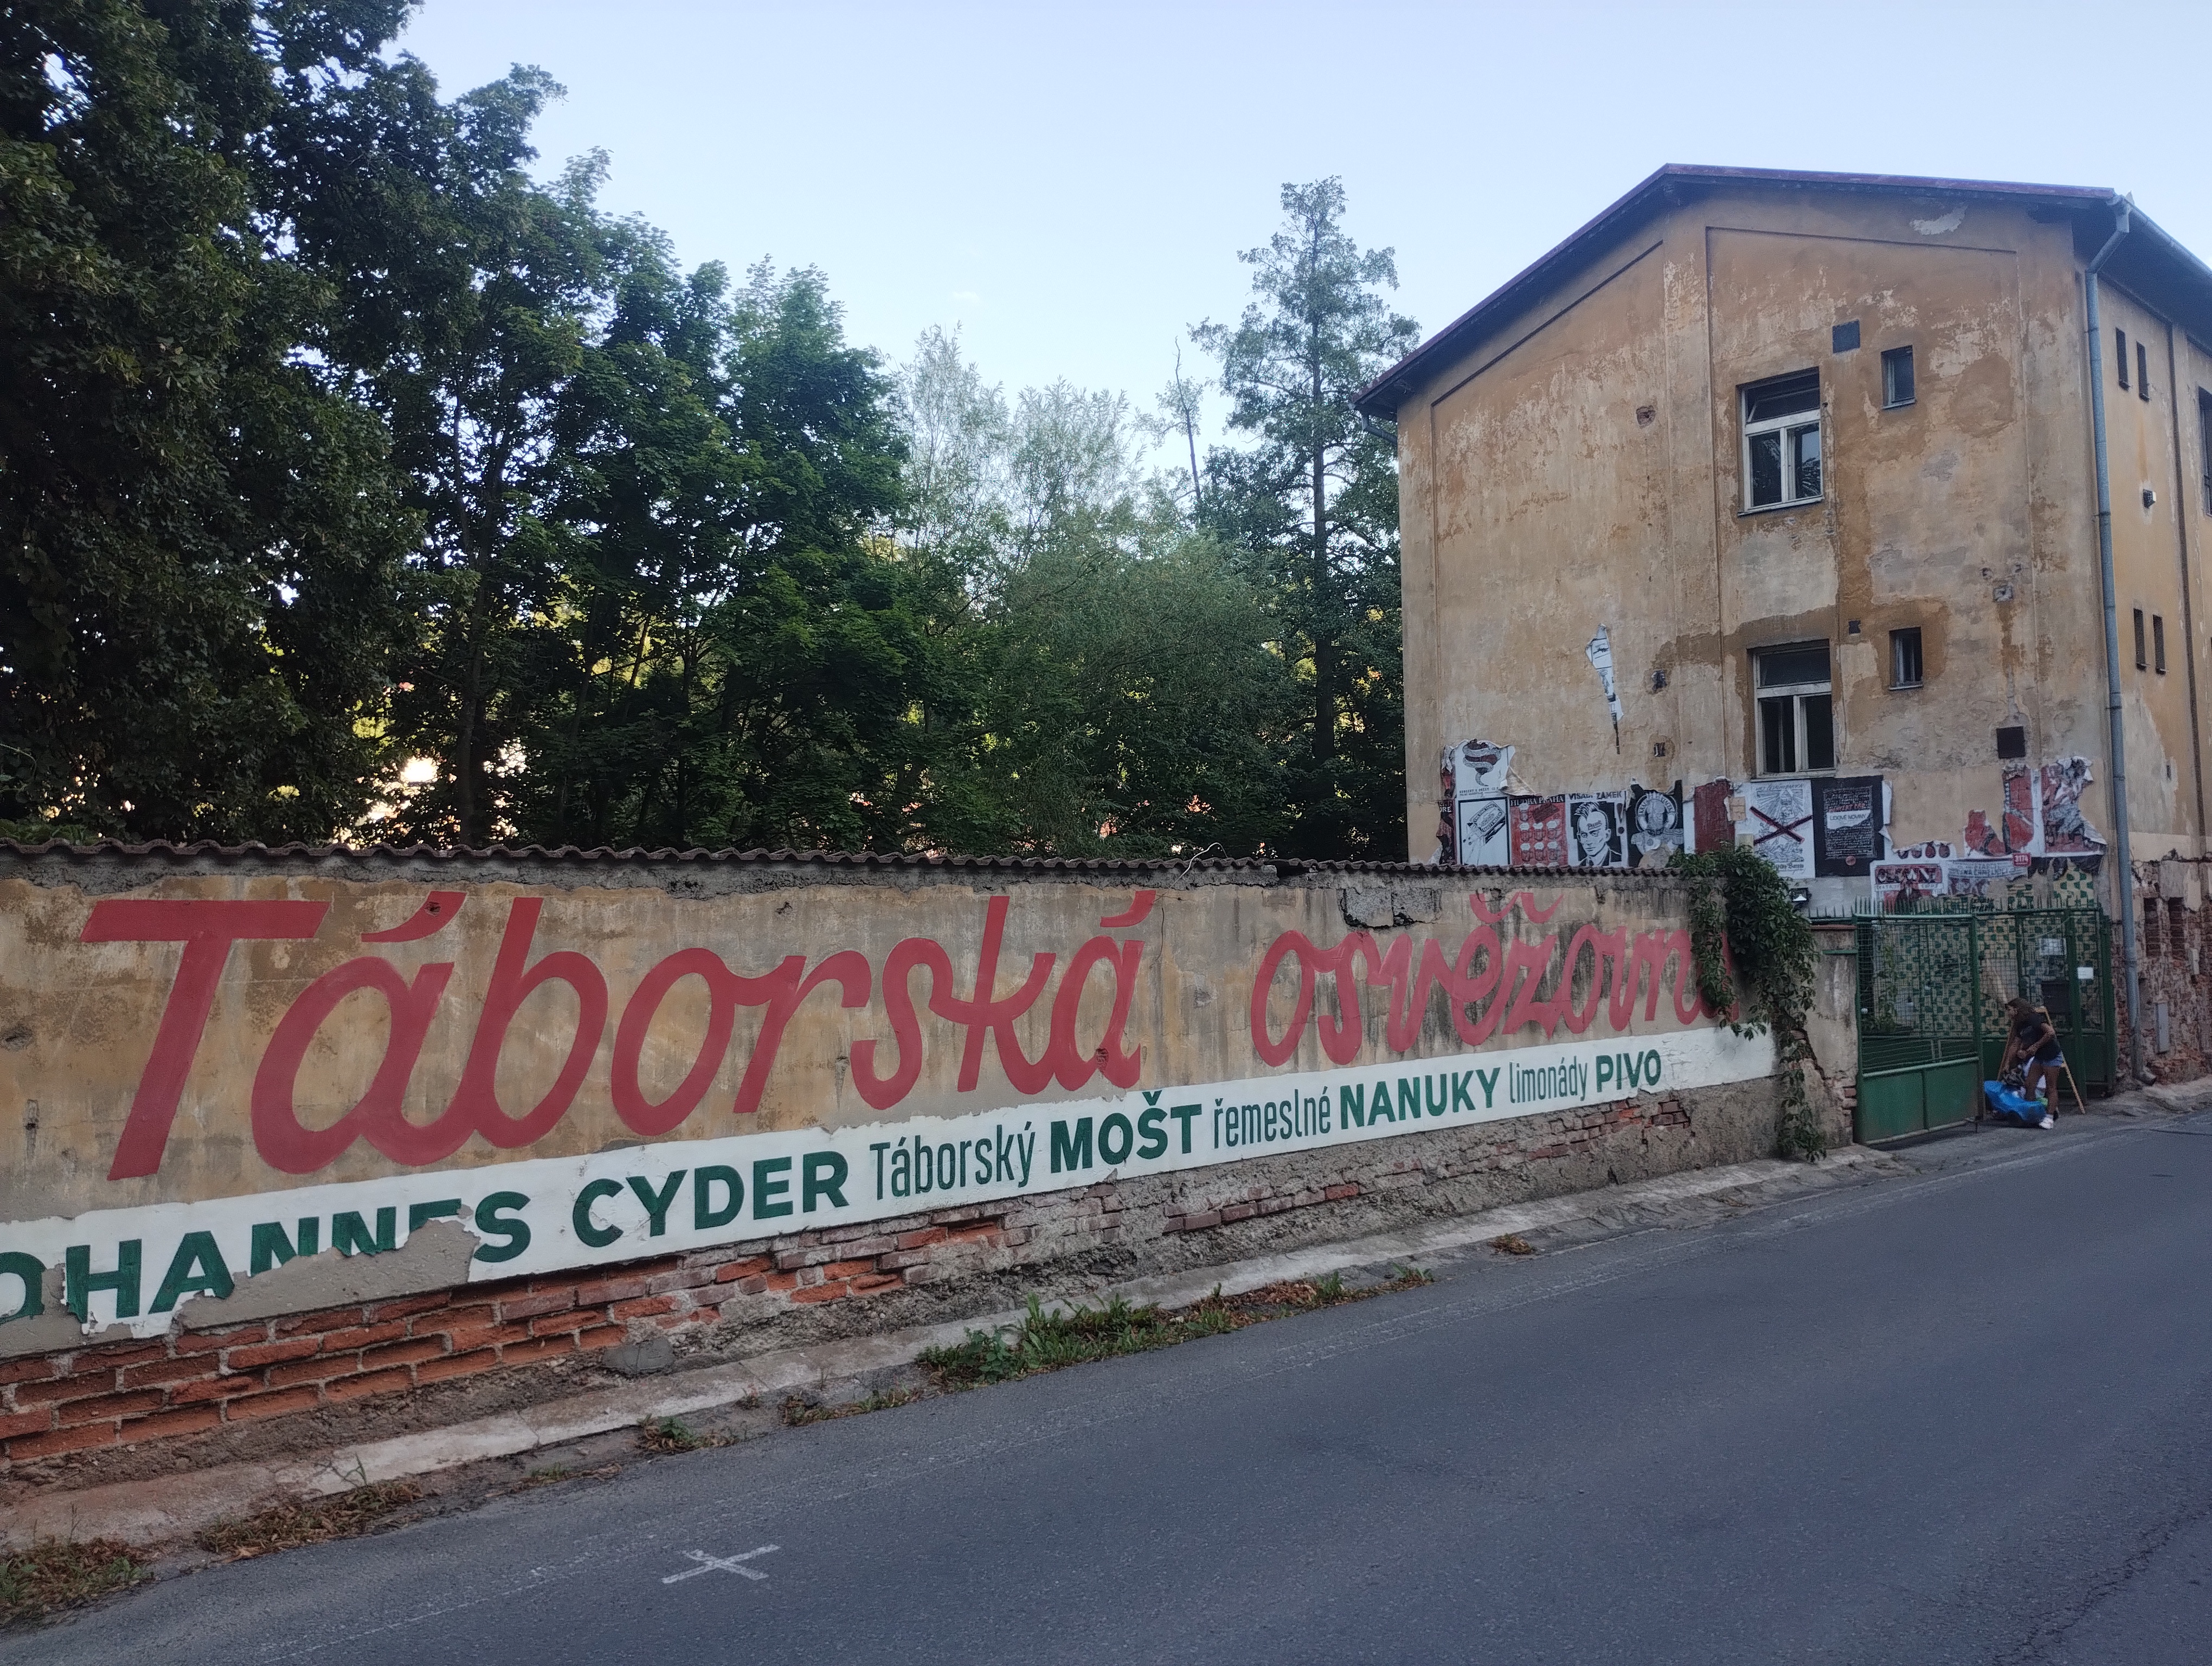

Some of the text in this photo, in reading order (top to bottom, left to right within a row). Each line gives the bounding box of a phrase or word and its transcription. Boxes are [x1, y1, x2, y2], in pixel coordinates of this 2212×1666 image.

[80, 890, 1156, 1181] Táborská
[573, 1151, 850, 1248] CYDER
[869, 1121, 1036, 1200] Táborský
[1050, 1090, 1202, 1174] MOŠT
[1213, 1086, 1330, 1149] řemeslné
[1340, 1067, 1501, 1130] NANUKY
[1509, 1055, 1587, 1101] limonády
[1596, 1049, 1662, 1093] PIVO
